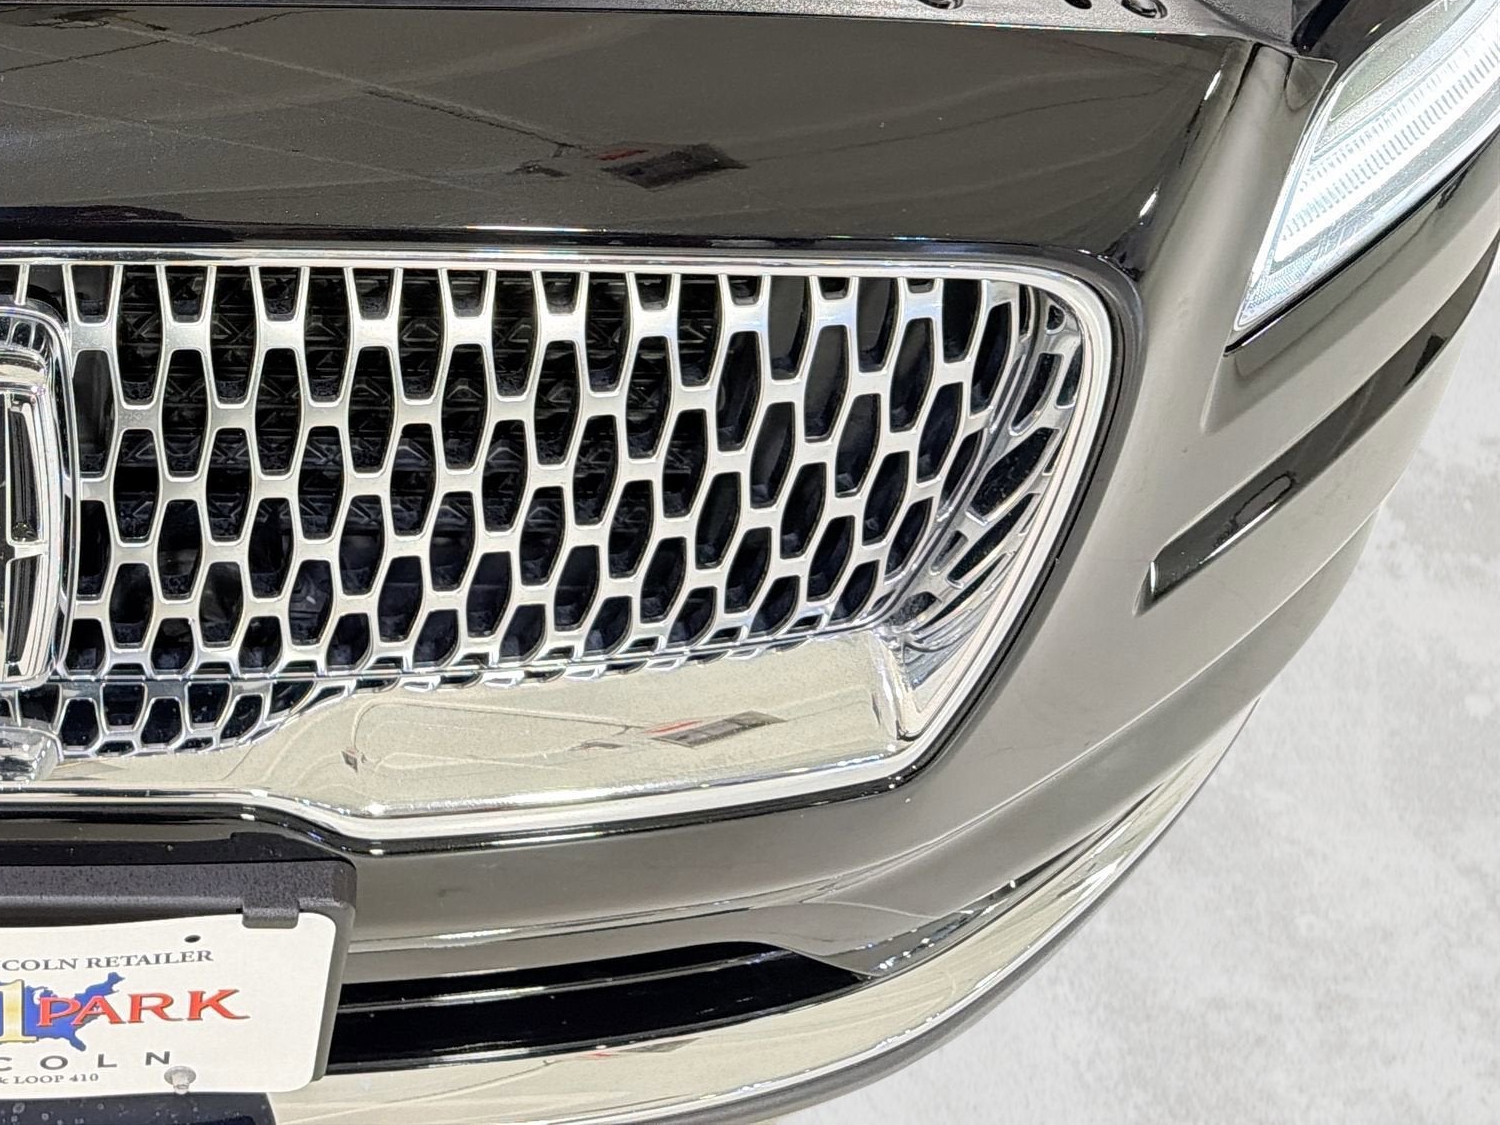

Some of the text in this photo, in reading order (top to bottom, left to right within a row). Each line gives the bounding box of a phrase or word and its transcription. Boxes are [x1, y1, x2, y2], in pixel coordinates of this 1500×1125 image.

[85, 950, 214, 969] RETAILER
[37, 989, 251, 1028] PARK
[13, 1074, 64, 1085] LOOP
[69, 1072, 99, 1083] 410
